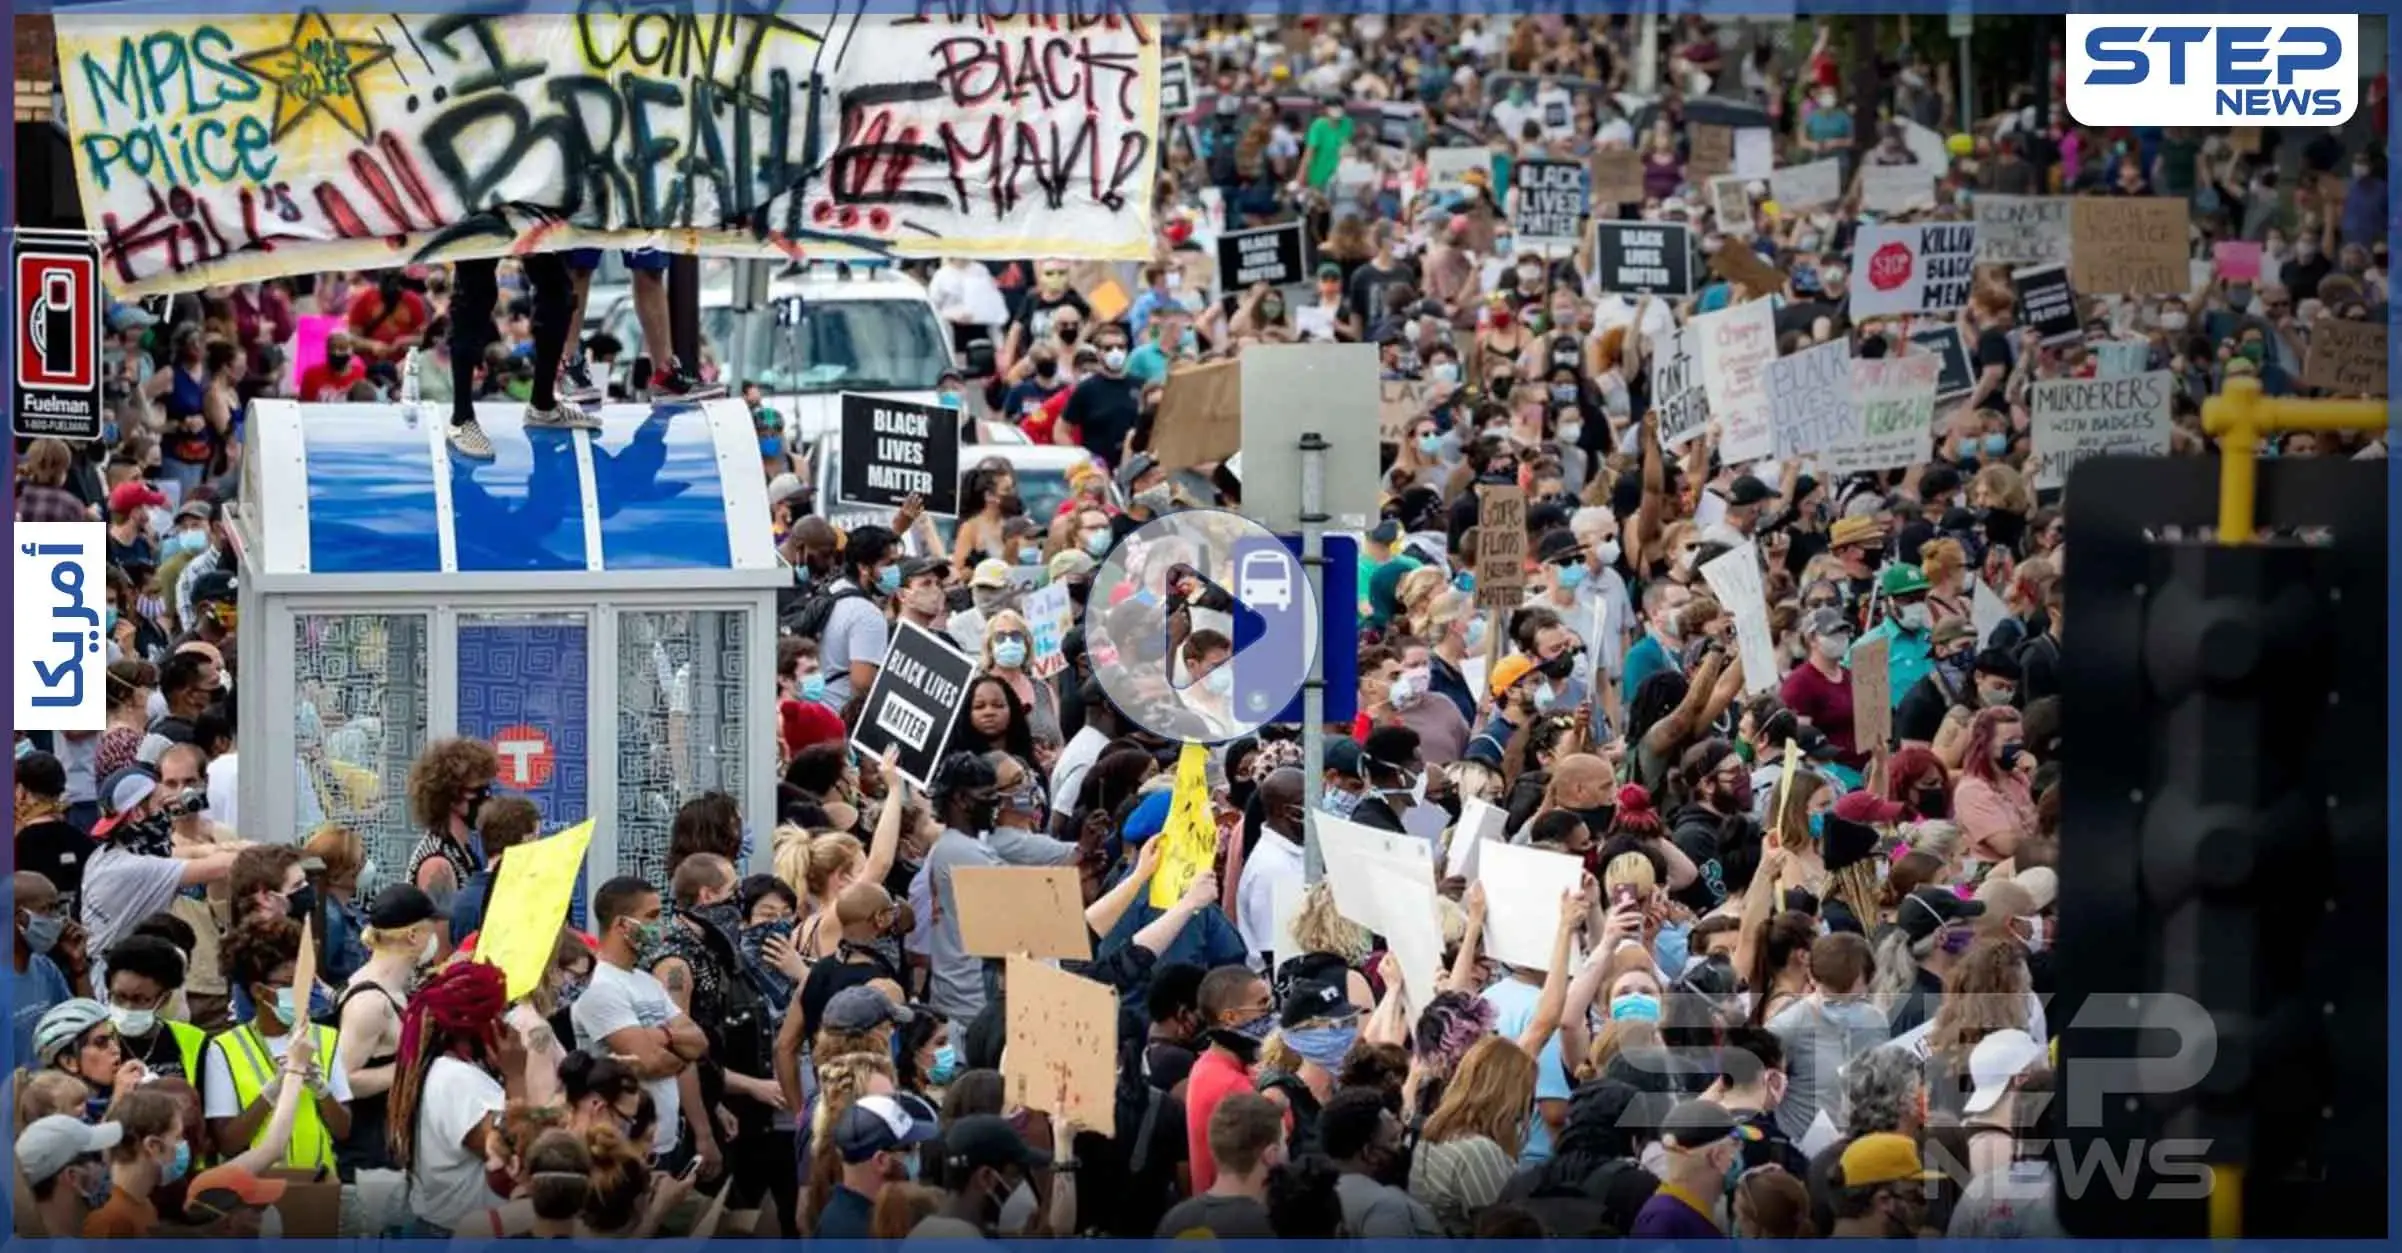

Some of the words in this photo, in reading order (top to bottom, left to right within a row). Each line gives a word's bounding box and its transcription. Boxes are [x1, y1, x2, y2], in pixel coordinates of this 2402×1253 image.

[930, 35, 1138, 121] BLACK
[1519, 163, 1581, 189] BLACK
[1522, 190, 1580, 215] LIVES
[1519, 213, 1577, 236] MATTER
[1238, 232, 1279, 253] BLACK
[1621, 229, 1664, 248] BLACK
[1243, 249, 1278, 267] LIVES
[1624, 248, 1662, 266] LIVES
[1875, 252, 1909, 275] STOP
[1237, 263, 1286, 284] MATTER
[1618, 265, 1670, 286] MATTER
[1672, 329, 1685, 360] I
[1771, 341, 1848, 399] BLACK
[23, 392, 90, 414] Fuelman
[1773, 386, 1836, 426] LIVES
[2037, 376, 2162, 413] MURDERERS
[873, 408, 928, 437] BLACK
[1775, 401, 1860, 459] MATTER
[2091, 411, 2154, 431] BADGES
[877, 437, 924, 465] LIVES
[867, 464, 933, 495] MATTER
[886, 649, 927, 690] BLACK
[922, 671, 960, 709] LIVES
[882, 701, 928, 742] MATTER
